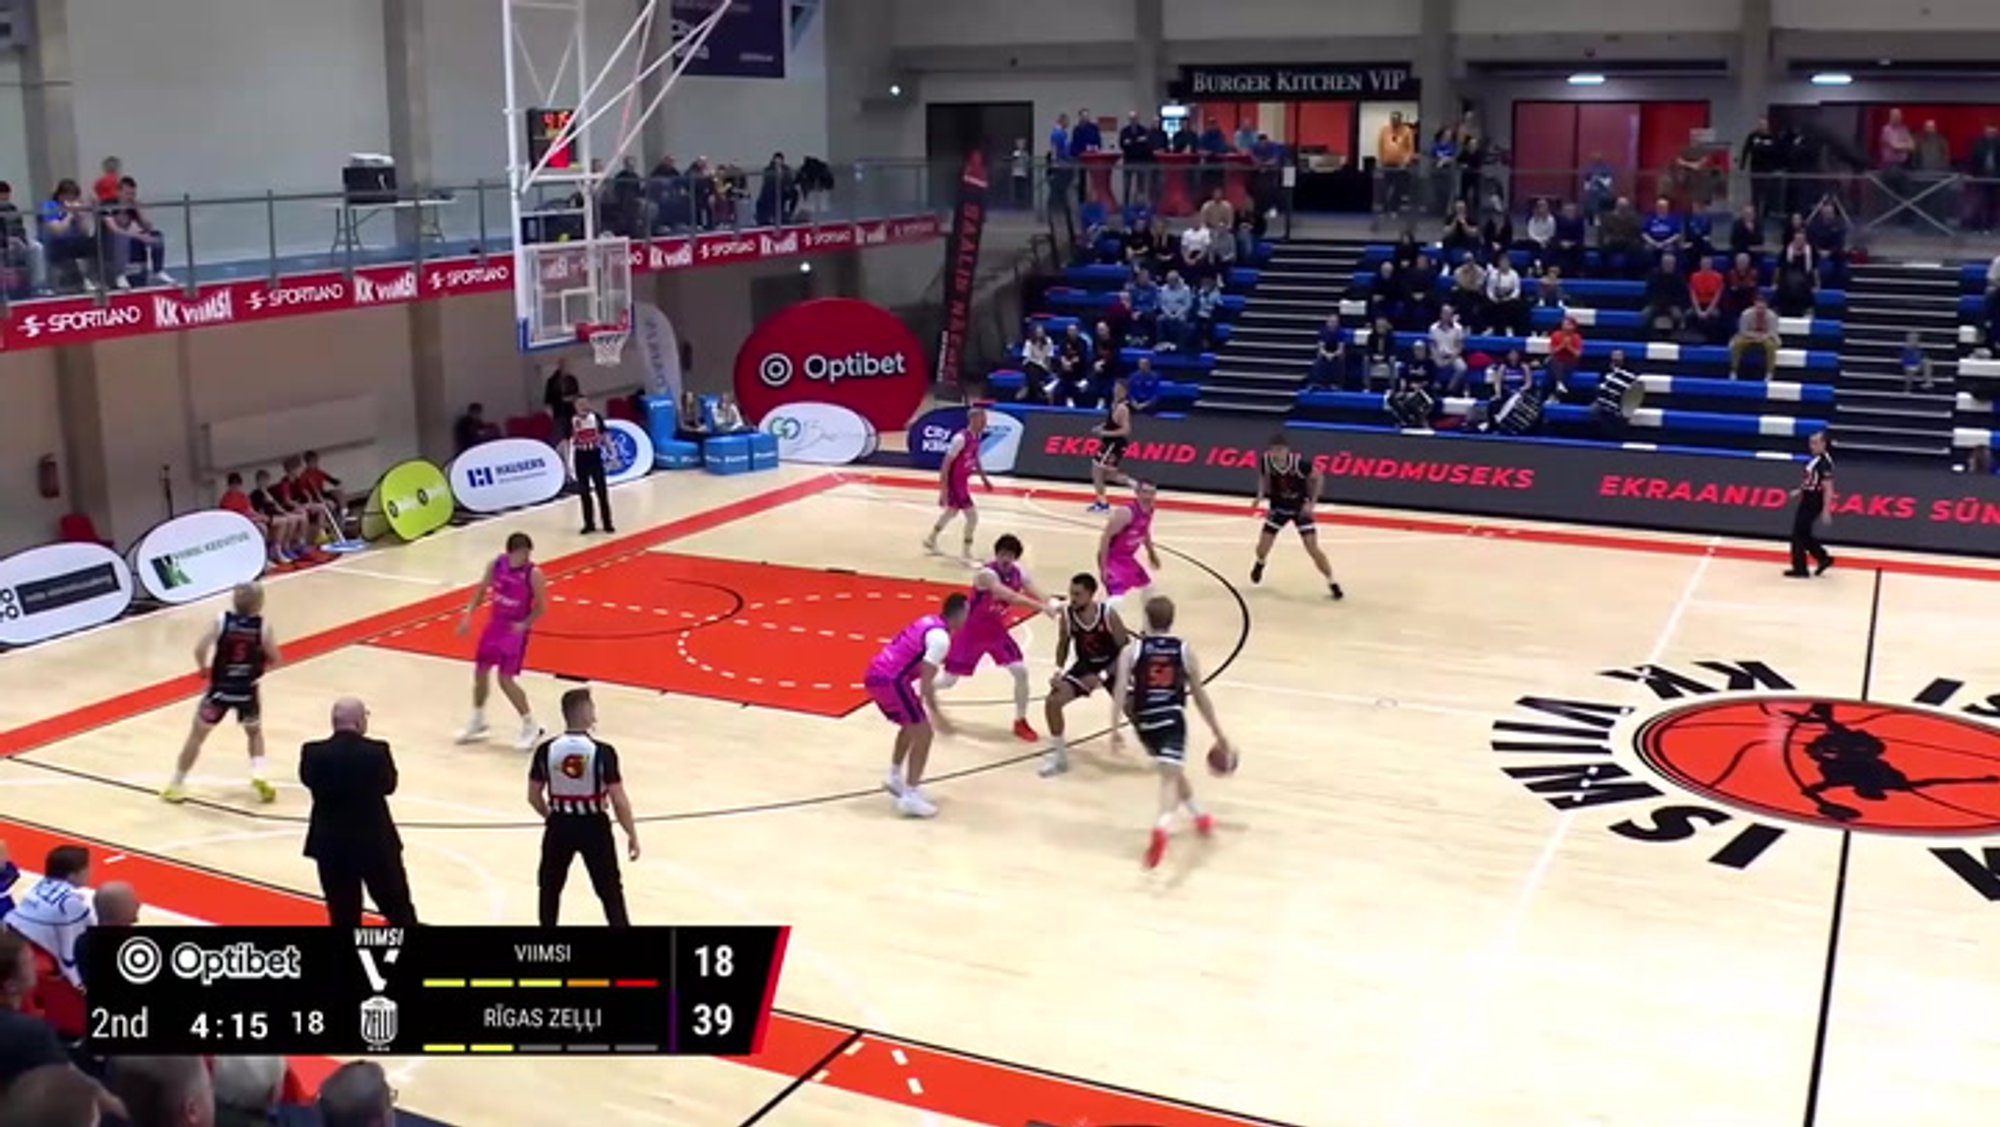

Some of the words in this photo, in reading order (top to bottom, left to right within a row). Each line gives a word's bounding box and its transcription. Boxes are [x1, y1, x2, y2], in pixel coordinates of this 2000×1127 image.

[1193, 71, 1271, 93] BURGER
[1276, 70, 1362, 91] KITCHEN
[1368, 69, 1405, 91] VIP
[268, 283, 344, 307] SPORTLAND
[47, 304, 142, 333] SPORTLAND
[153, 295, 180, 328] KK
[804, 351, 906, 384] Optibet
[1044, 434, 1198, 464] EKRANID
[1600, 474, 1788, 510] EKRAANID
